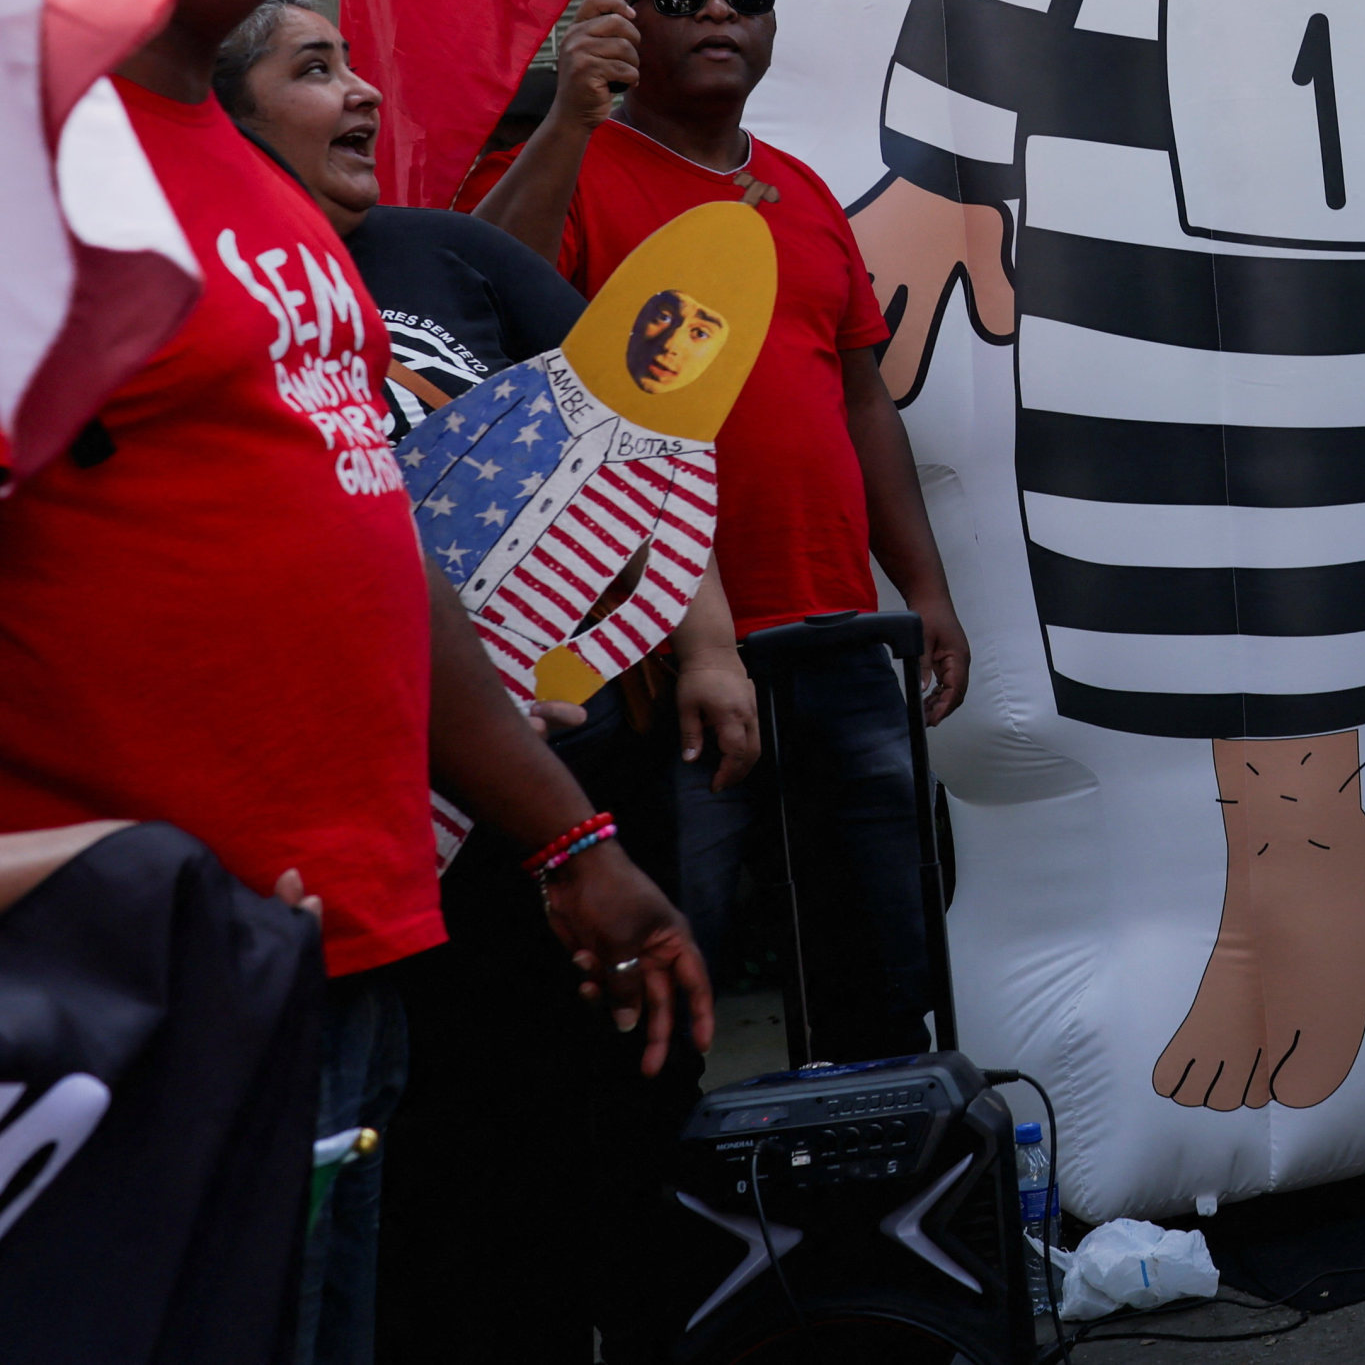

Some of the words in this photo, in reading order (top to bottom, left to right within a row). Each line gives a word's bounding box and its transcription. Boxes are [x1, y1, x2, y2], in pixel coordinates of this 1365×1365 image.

[216, 228, 365, 361] SEM
[376, 309, 418, 326] RES
[420, 319, 455, 344] SEM
[453, 343, 489, 372] TETO
[546, 354, 594, 424] LAMBE
[617, 431, 683, 456] BOTAS
